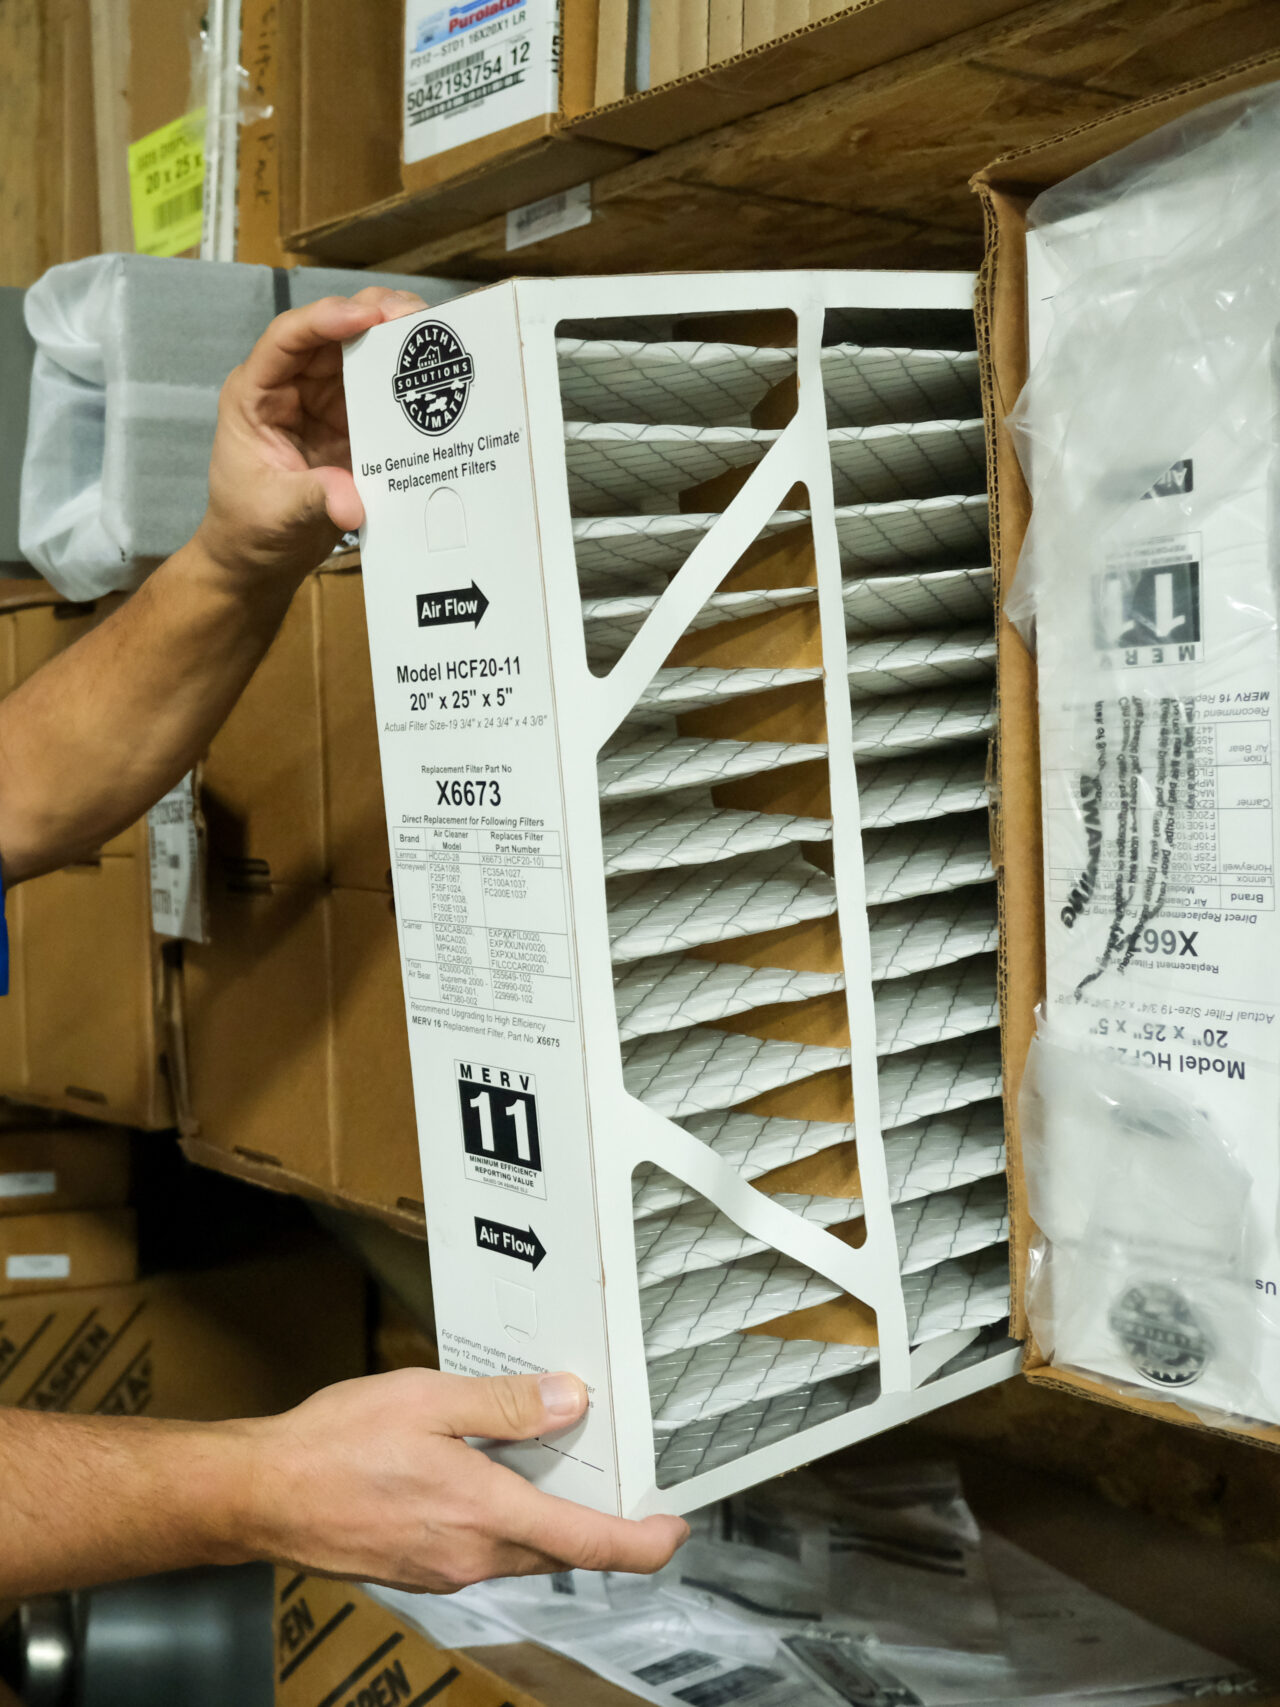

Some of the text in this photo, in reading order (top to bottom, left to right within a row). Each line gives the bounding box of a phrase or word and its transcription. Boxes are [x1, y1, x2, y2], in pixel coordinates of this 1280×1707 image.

[512, 10, 526, 26] LR
[407, 41, 530, 111] 5042193754 12
[402, 328, 457, 367] HEALTHY
[397, 361, 468, 390] SOLUTIONS
[409, 390, 464, 428] CLIMATE
[361, 463, 382, 477] Use
[385, 451, 430, 471] Genuine
[433, 441, 474, 462] Healthy
[388, 459, 497, 492] Replacement Filters
[421, 598, 478, 619] Air Flow
[396, 655, 521, 684] Model HCF20-11
[410, 687, 513, 711] 20" x 25" x 5"
[1219, 691, 1270, 702] MERV 16
[384, 720, 407, 732] Actual
[409, 720, 427, 731] Filter
[460, 717, 476, 729] 3/4"
[484, 717, 494, 727] 24
[496, 716, 513, 727] 3/4"
[522, 716, 527, 726] 4
[530, 714, 548, 726] 3/8"
[1228, 743, 1253, 753] Bear
[1243, 754, 1269, 763] Trion
[421, 764, 512, 776] Replacement Filter Part No
[436, 780, 501, 806] X6673
[1236, 798, 1271, 807] Carrier
[402, 814, 544, 828] Direct Replacement for Following Filters
[399, 834, 420, 843] Brand
[433, 830, 469, 839] Air Cleaner
[490, 831, 544, 842] Replaces Filter
[442, 842, 462, 851] Model
[495, 844, 540, 854] Part Number
[396, 862, 427, 873] Honeywell
[481, 855, 545, 867] X6673 (HCF20-10)
[1223, 863, 1273, 873] Honeywell
[1237, 875, 1273, 883] Lennox
[1231, 892, 1264, 903] Brand
[1225, 913, 1258, 924] Direct
[1156, 963, 1220, 974] Replacement
[439, 973, 467, 985] Supreme
[410, 1001, 546, 1032] Recommend Upgrading to High Efficiency
[1204, 1009, 1233, 1020] Filter
[1237, 1011, 1275, 1024] Actual
[412, 1015, 432, 1027] MERV
[433, 1019, 442, 1028] 16
[443, 1020, 486, 1036] Replacement
[507, 1031, 522, 1041] Part
[523, 1033, 534, 1044] No
[536, 1035, 561, 1048] X6675
[1116, 1019, 1127, 1033] x
[1133, 1023, 1166, 1042] 25"
[1173, 1025, 1185, 1039] x
[1191, 1028, 1229, 1049] 20"
[1179, 1055, 1246, 1080] Model
[460, 1063, 529, 1091] MERV
[469, 1091, 531, 1161] 11
[469, 1155, 538, 1178] MINIMUM EFFICIENCY
[475, 1165, 512, 1181] REPORTING
[513, 1175, 534, 1188] VALUE
[479, 1225, 535, 1257] Air Flow
[1255, 1279, 1277, 1296] Us
[442, 1329, 506, 1360] For optimum system
[442, 1344, 460, 1357] every
[461, 1348, 470, 1360] 12
[500, 1364, 518, 1376] More
[444, 1357, 468, 1372] may be
